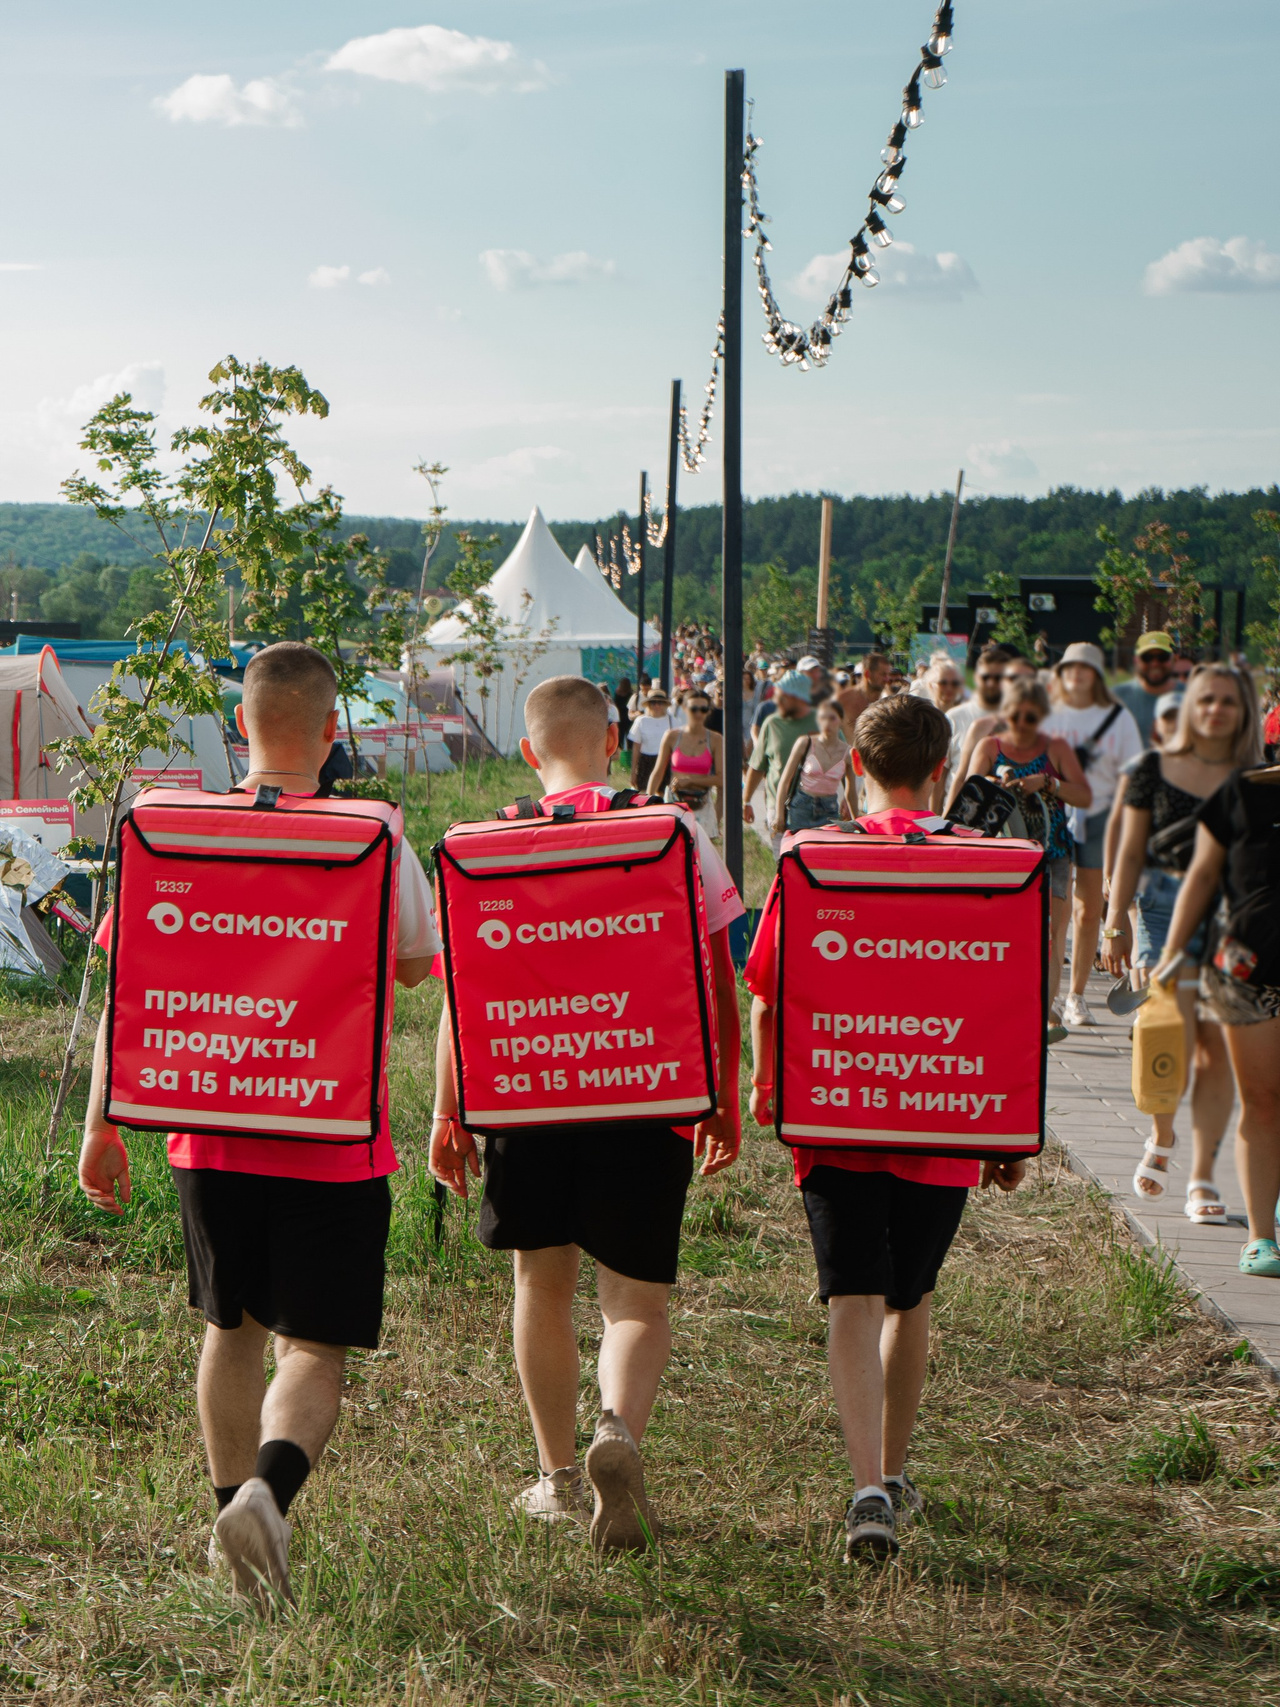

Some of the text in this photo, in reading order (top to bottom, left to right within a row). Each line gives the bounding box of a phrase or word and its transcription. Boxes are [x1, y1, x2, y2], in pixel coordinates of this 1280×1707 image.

[15, 805, 69, 814] Семейный
[155, 879, 193, 894] 12337
[478, 899, 514, 912] 12288
[816, 908, 855, 921] 87753
[189, 911, 348, 942] самокат
[515, 911, 664, 944] самокат
[853, 937, 1010, 962] самокат
[144, 989, 298, 1028] принесу
[485, 991, 629, 1026] принесу
[490, 1027, 654, 1062] продукты
[812, 1012, 964, 1045] принесу
[143, 1028, 316, 1064] продукты
[493, 1061, 681, 1094] за 15 минут
[811, 1048, 984, 1080] продукты
[139, 1067, 339, 1107] за 15 минут
[810, 1086, 1008, 1120] за 15 минут
